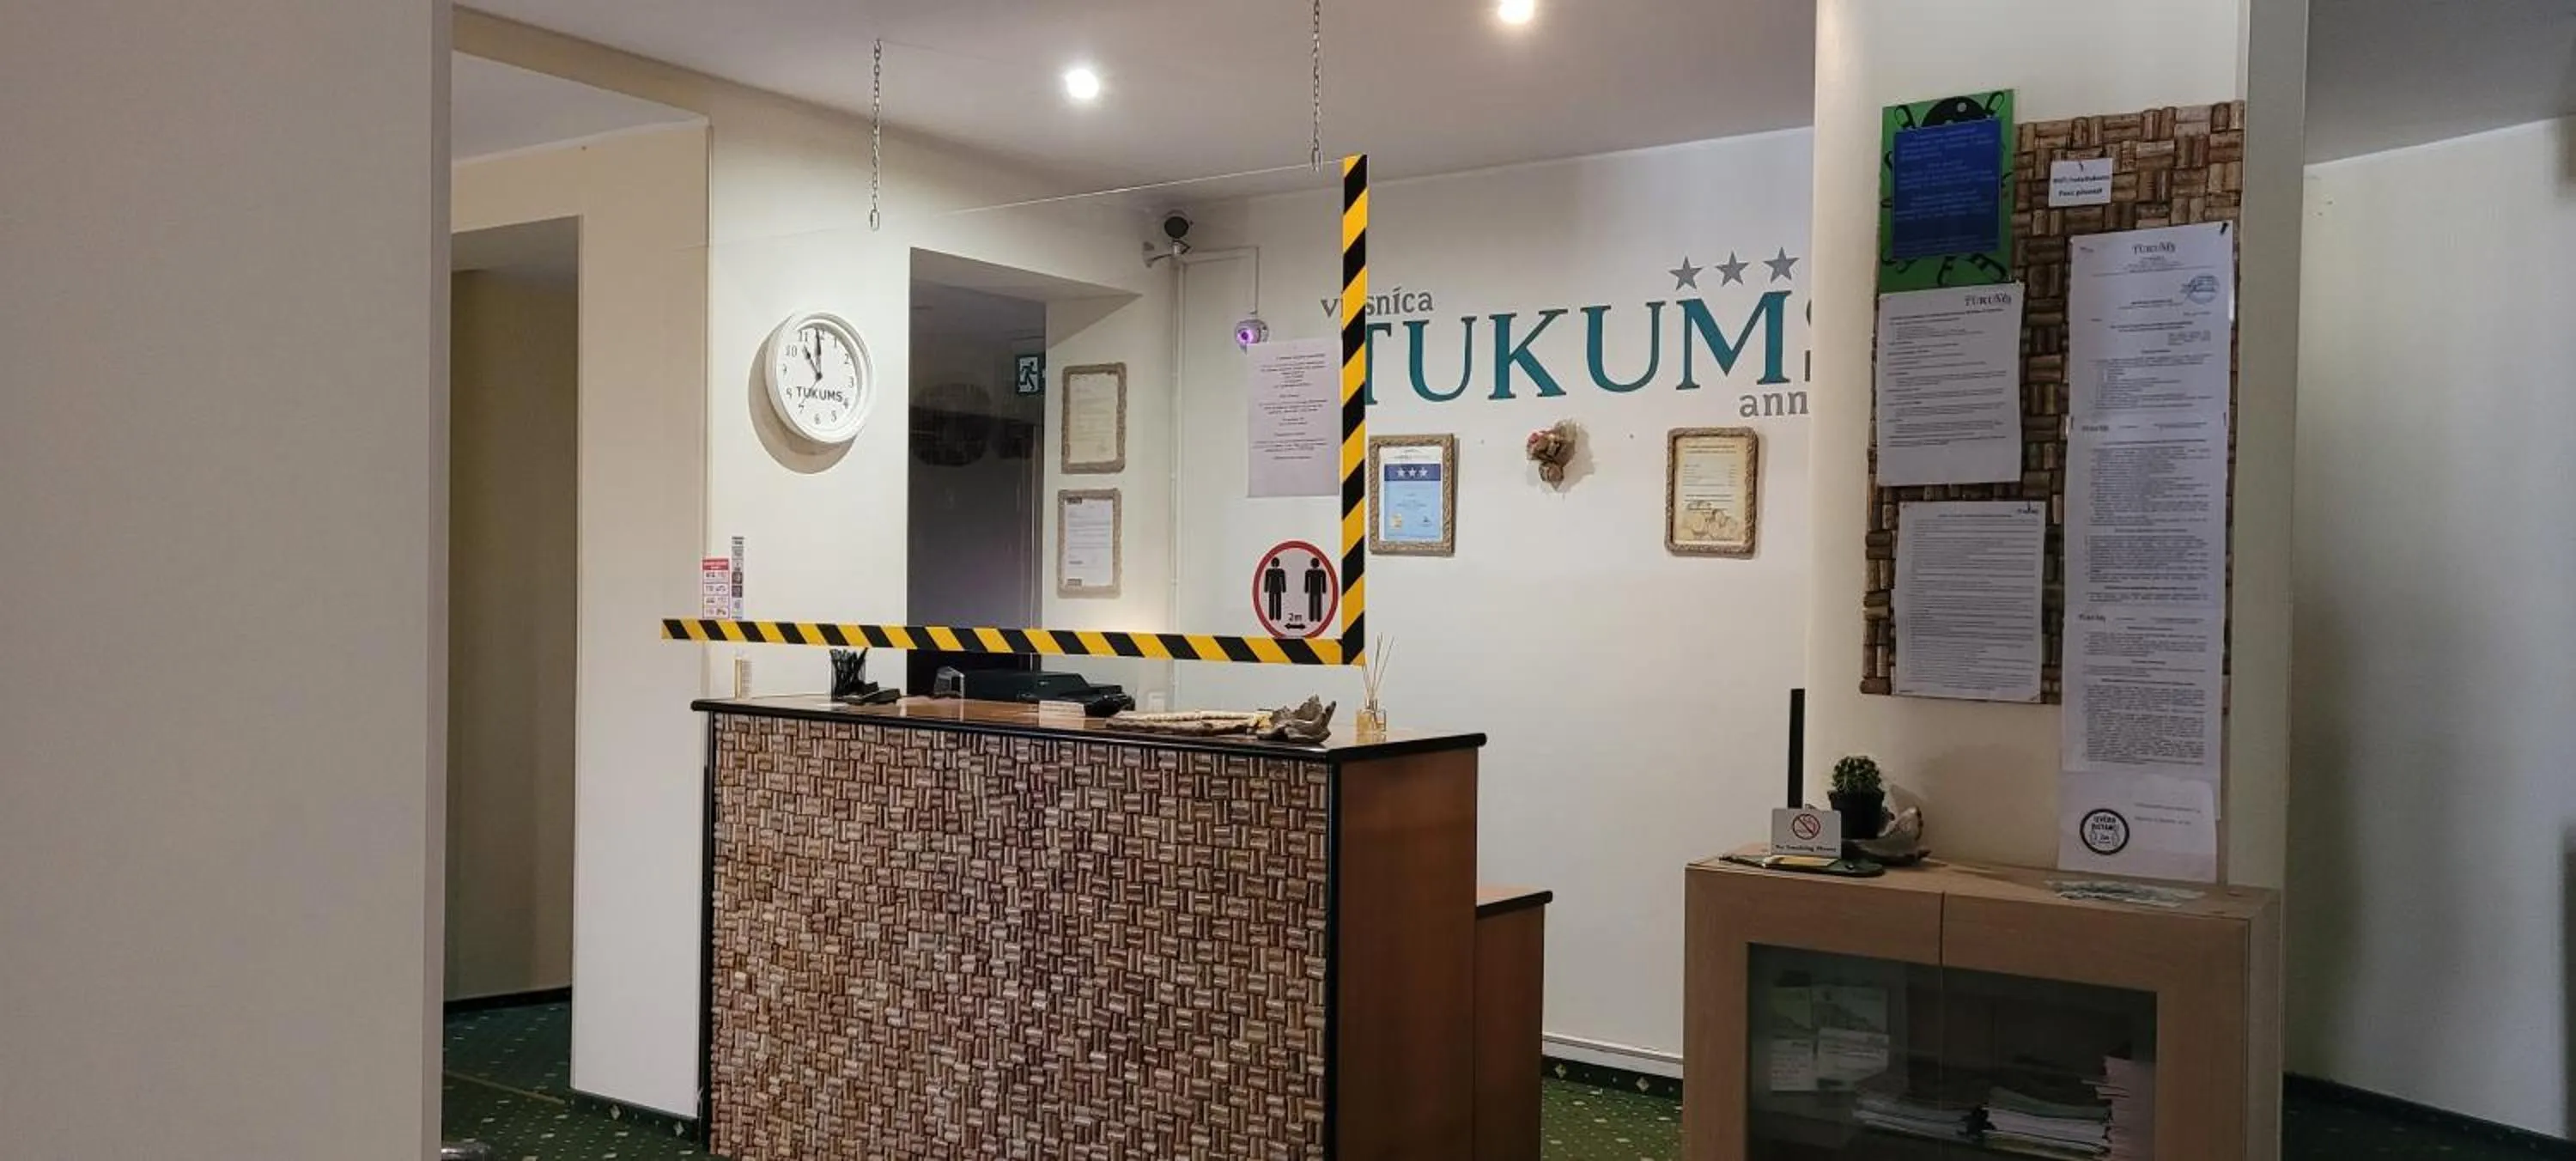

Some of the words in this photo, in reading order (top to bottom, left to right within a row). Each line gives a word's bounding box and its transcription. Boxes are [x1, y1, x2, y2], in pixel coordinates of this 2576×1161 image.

[1365, 289, 1812, 405] TUKUM
[797, 386, 843, 402] TUKUMS
[1288, 612, 1303, 622] 2m
